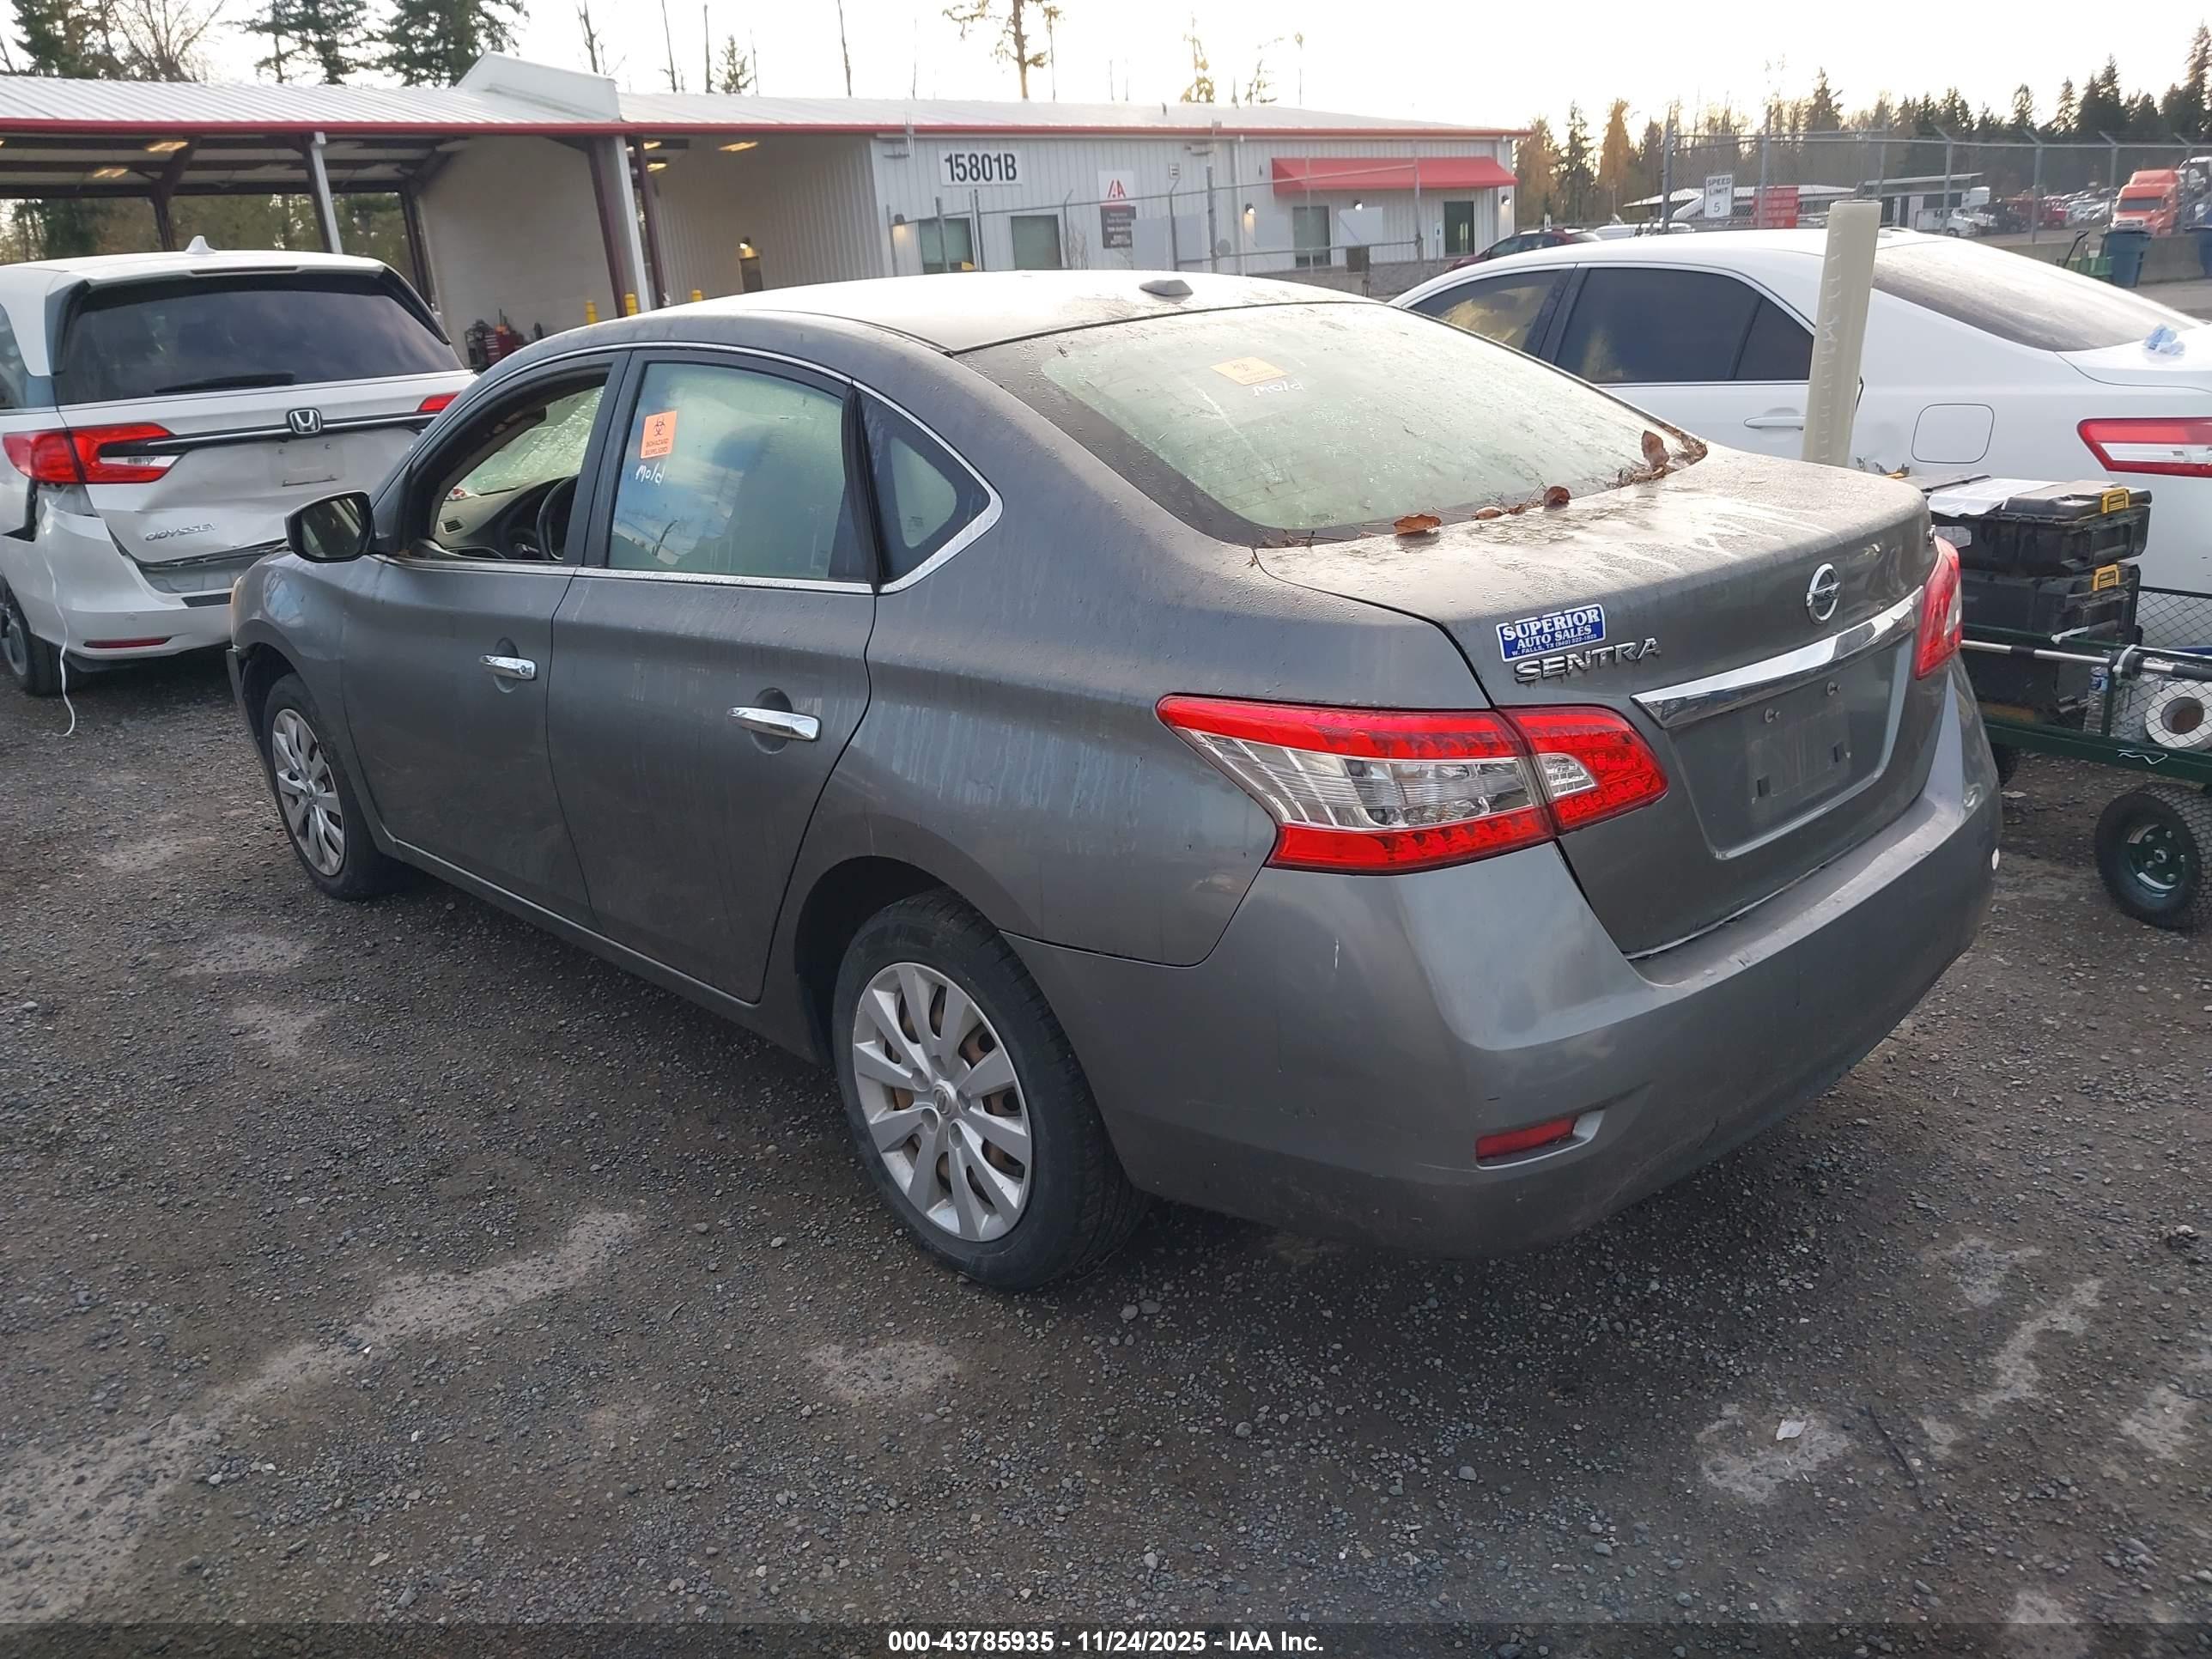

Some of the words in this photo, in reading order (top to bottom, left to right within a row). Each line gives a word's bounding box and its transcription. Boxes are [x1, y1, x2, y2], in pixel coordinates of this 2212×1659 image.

[945, 153, 1017, 182] 15801B
[1707, 177, 1731, 187] SPEED
[1709, 187, 1729, 197] LIMIT
[1713, 202, 1721, 213] 5
[635, 461, 666, 486] Mold
[145, 523, 216, 541] ODYSSEY
[1503, 608, 1601, 641] SUPERIOR
[1516, 633, 1551, 650] AUTO
[1554, 625, 1592, 641] SALES
[1515, 637, 1662, 684] SENTRA
